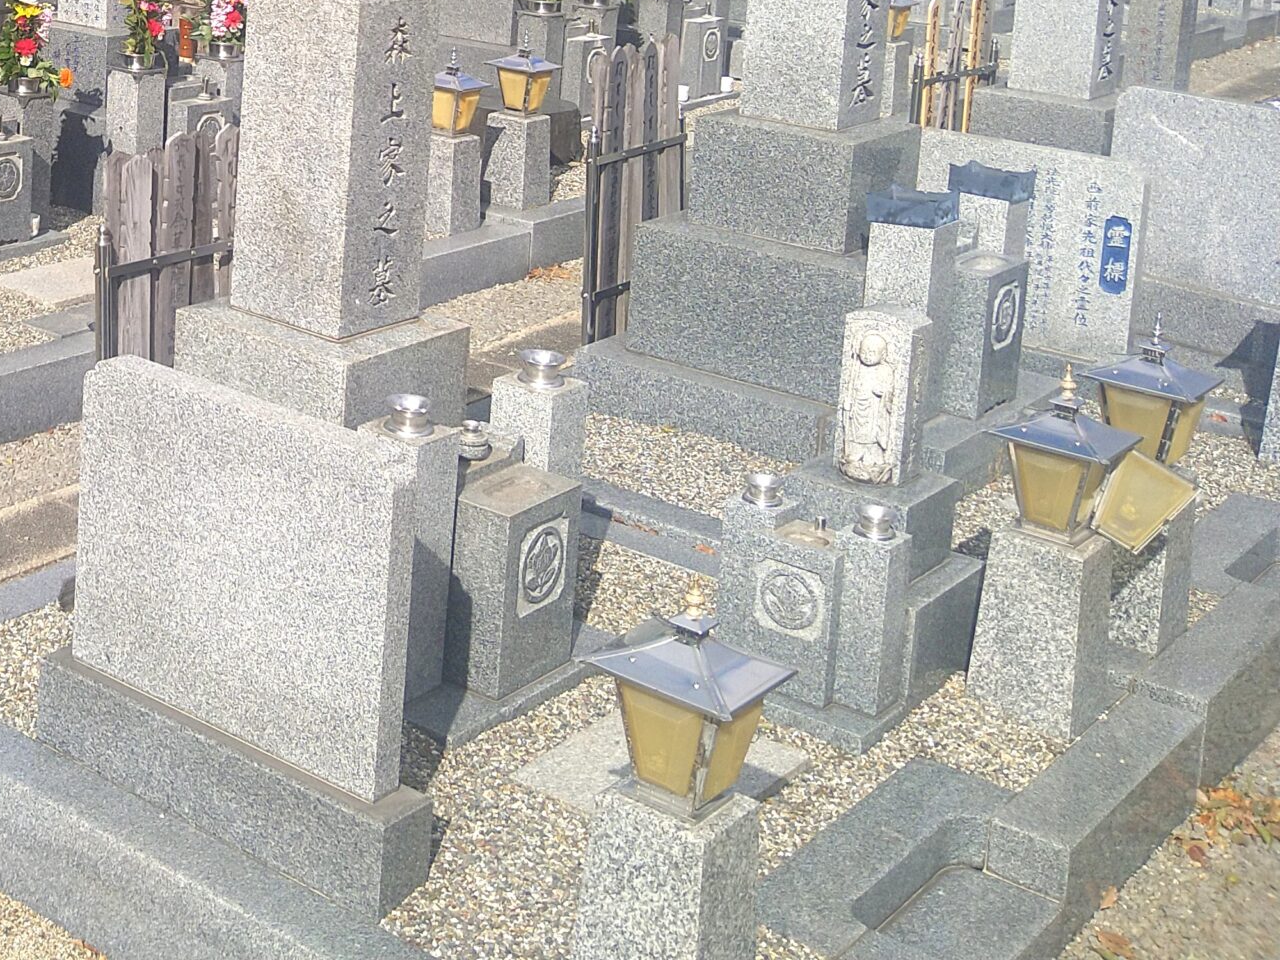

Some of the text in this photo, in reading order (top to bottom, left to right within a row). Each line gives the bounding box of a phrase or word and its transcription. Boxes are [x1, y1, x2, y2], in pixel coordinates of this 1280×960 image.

[369, 17, 413, 307] 森上家之墓
[1103, 226, 1130, 283] 霊標
